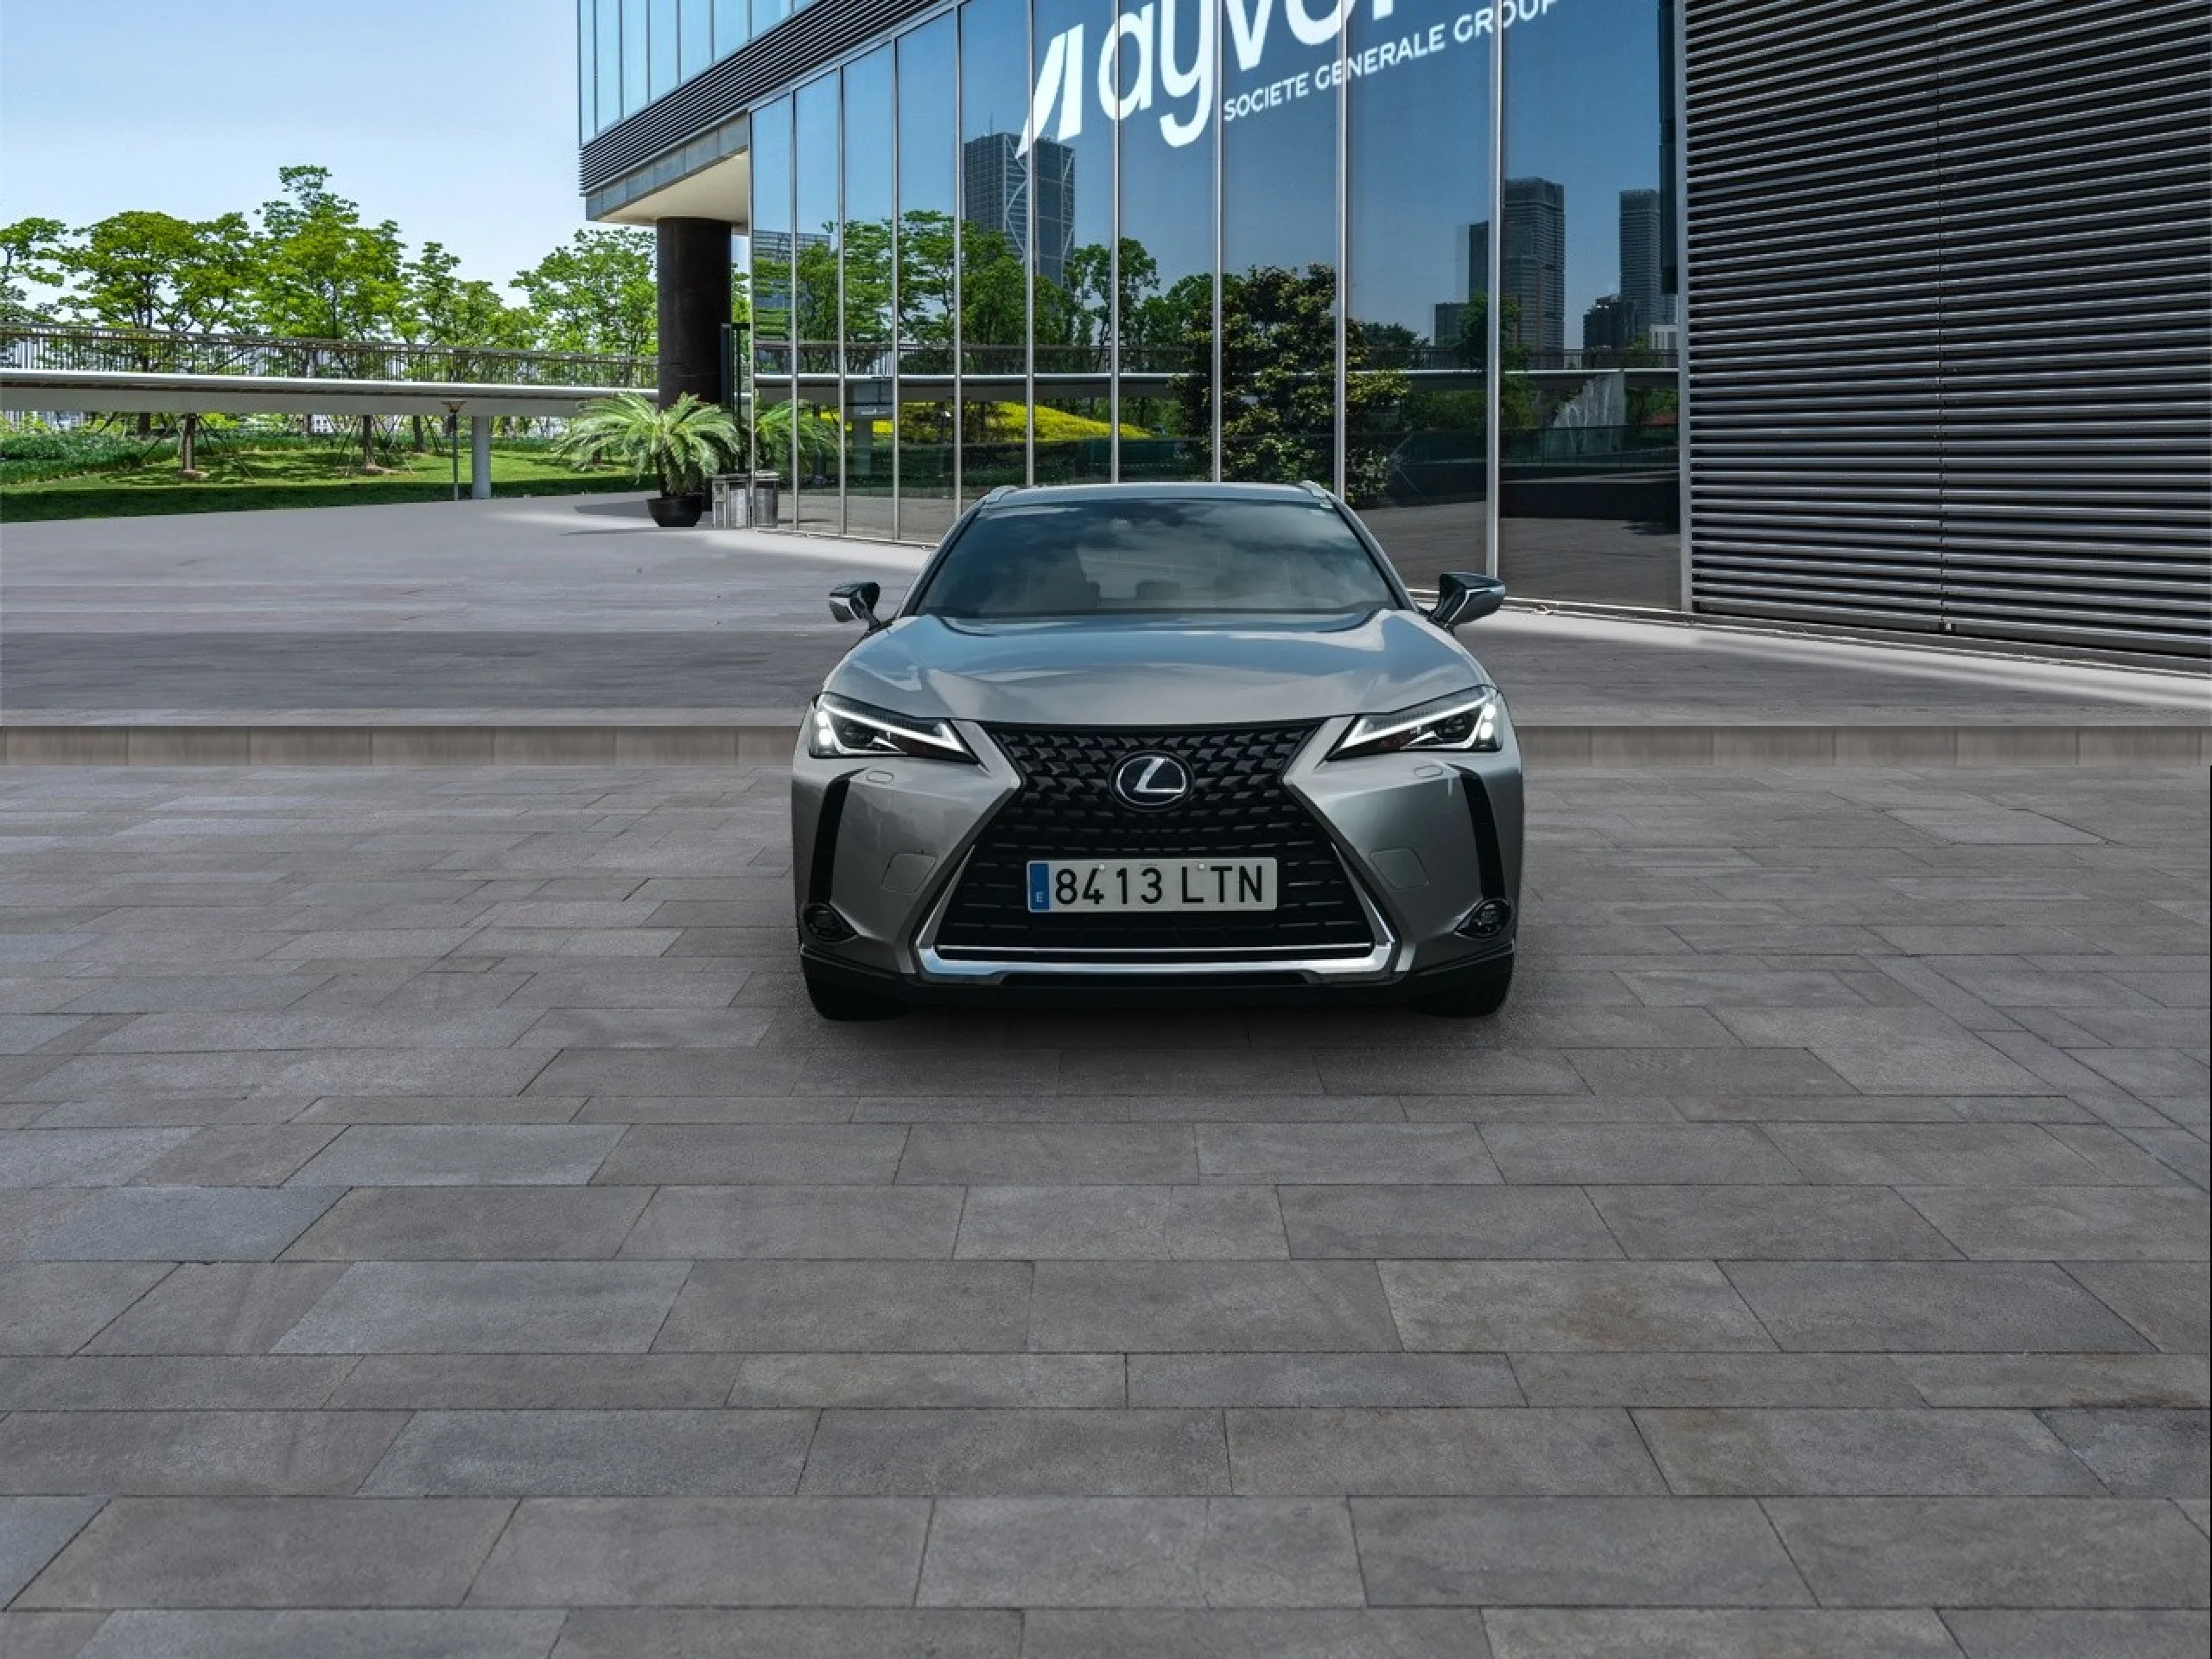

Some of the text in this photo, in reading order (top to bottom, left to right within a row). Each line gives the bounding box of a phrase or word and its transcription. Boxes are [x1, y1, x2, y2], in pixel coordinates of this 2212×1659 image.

[1224, 72, 1310, 122] SOCIETE
[1314, 23, 1446, 90] GENERALE
[1035, 865, 1262, 905] E 8413 LTN
